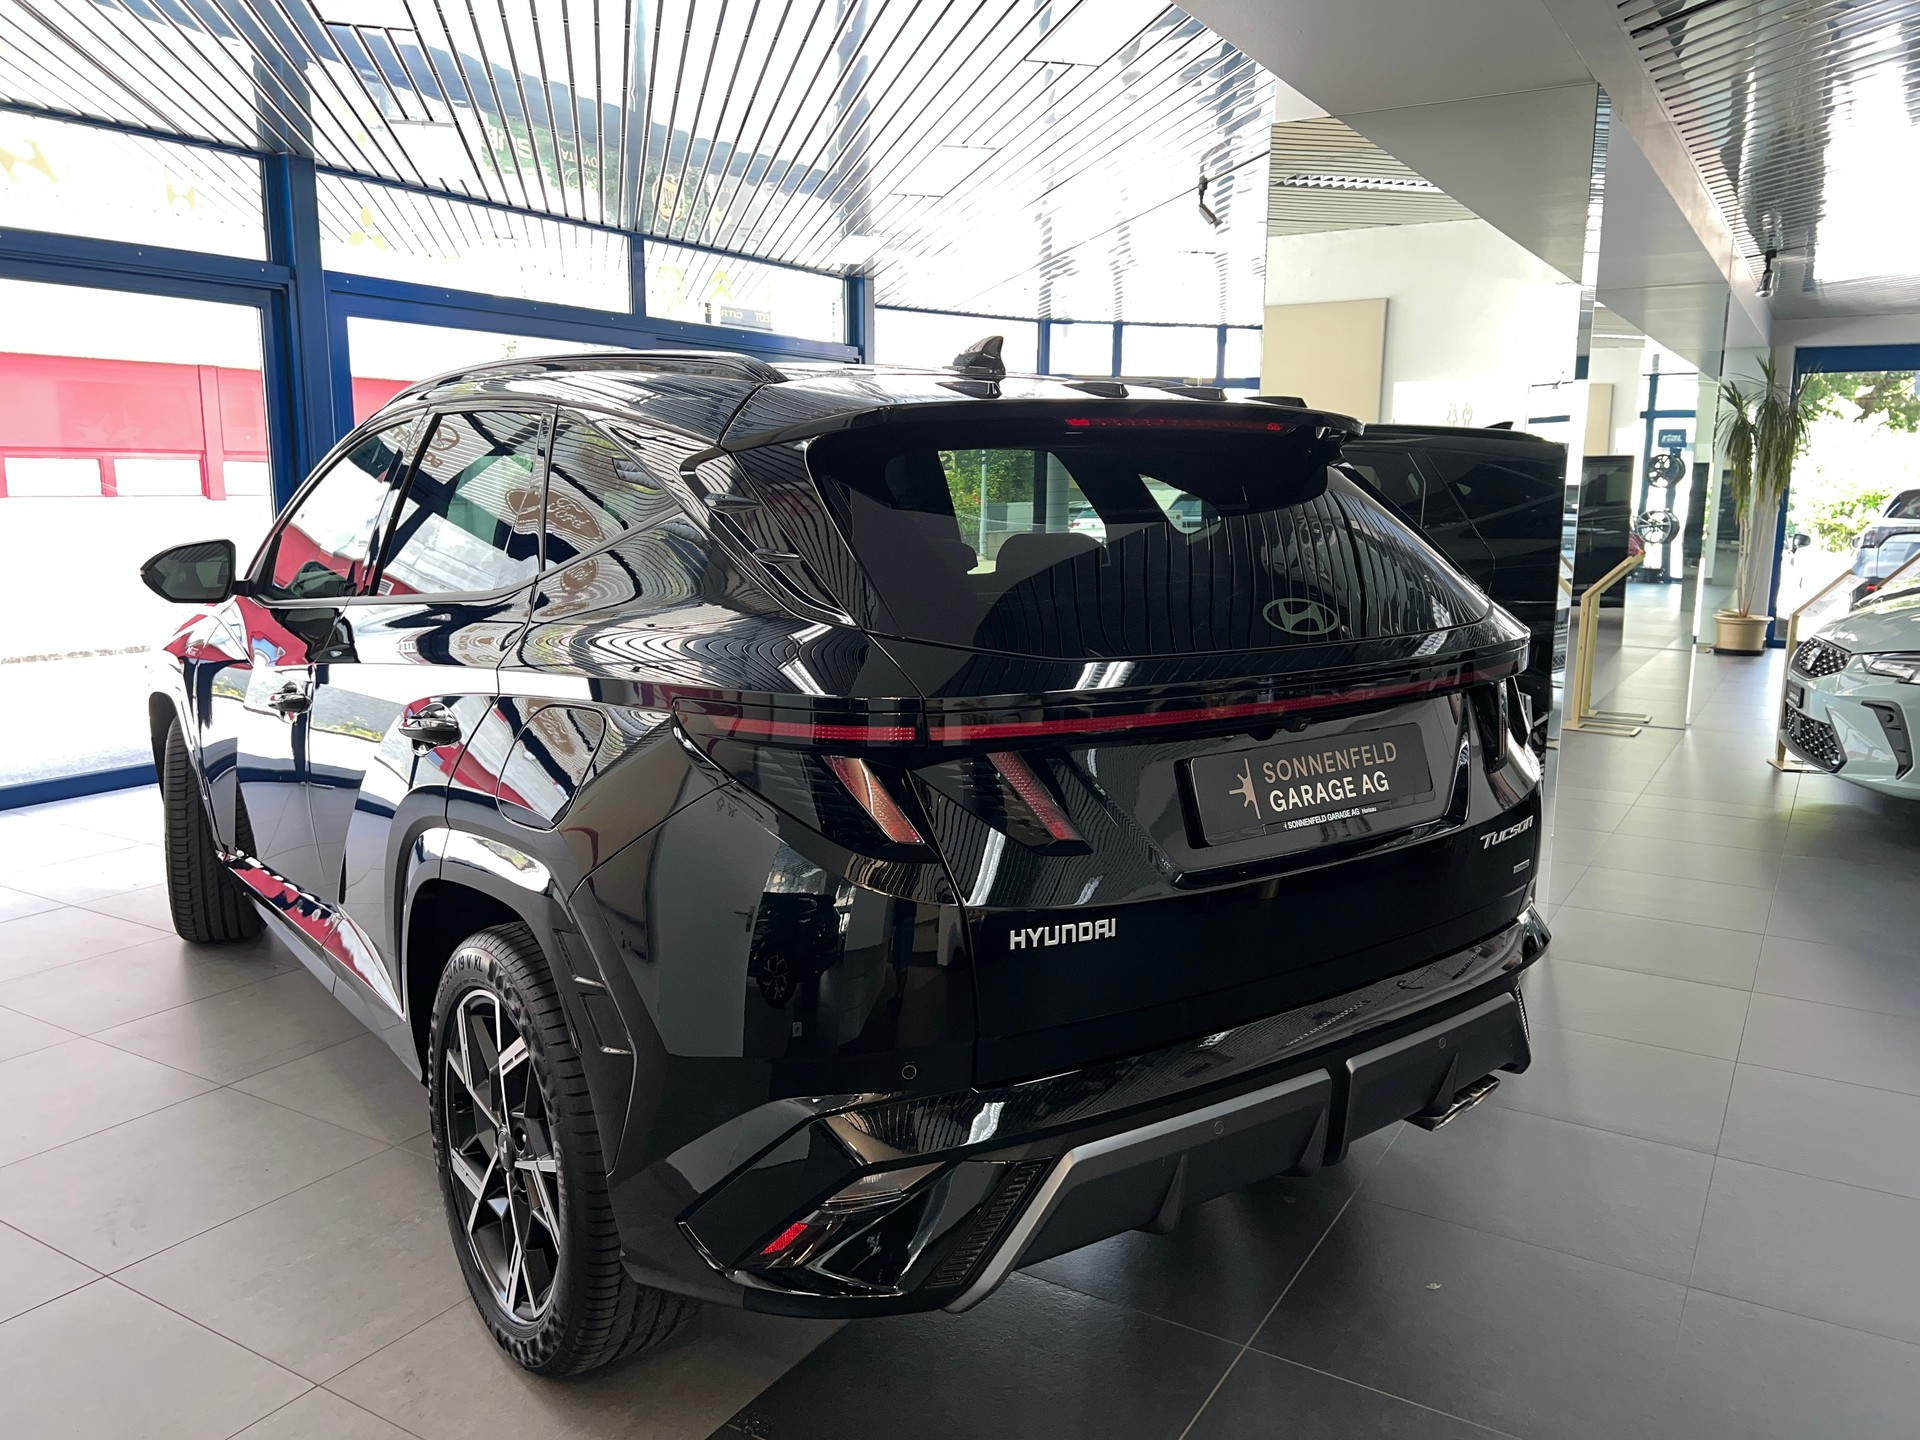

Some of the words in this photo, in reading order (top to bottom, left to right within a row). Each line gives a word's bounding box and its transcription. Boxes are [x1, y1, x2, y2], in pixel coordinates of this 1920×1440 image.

[1263, 742, 1397, 784] SONNENFELD
[1269, 776, 1357, 812] GARAGE
[1362, 771, 1390, 795] AG
[1287, 814, 1327, 829] SONNENFELD
[1327, 809, 1351, 821] GARAGE
[1351, 807, 1360, 816] AG
[1009, 918, 1116, 950] HYUNDAI
